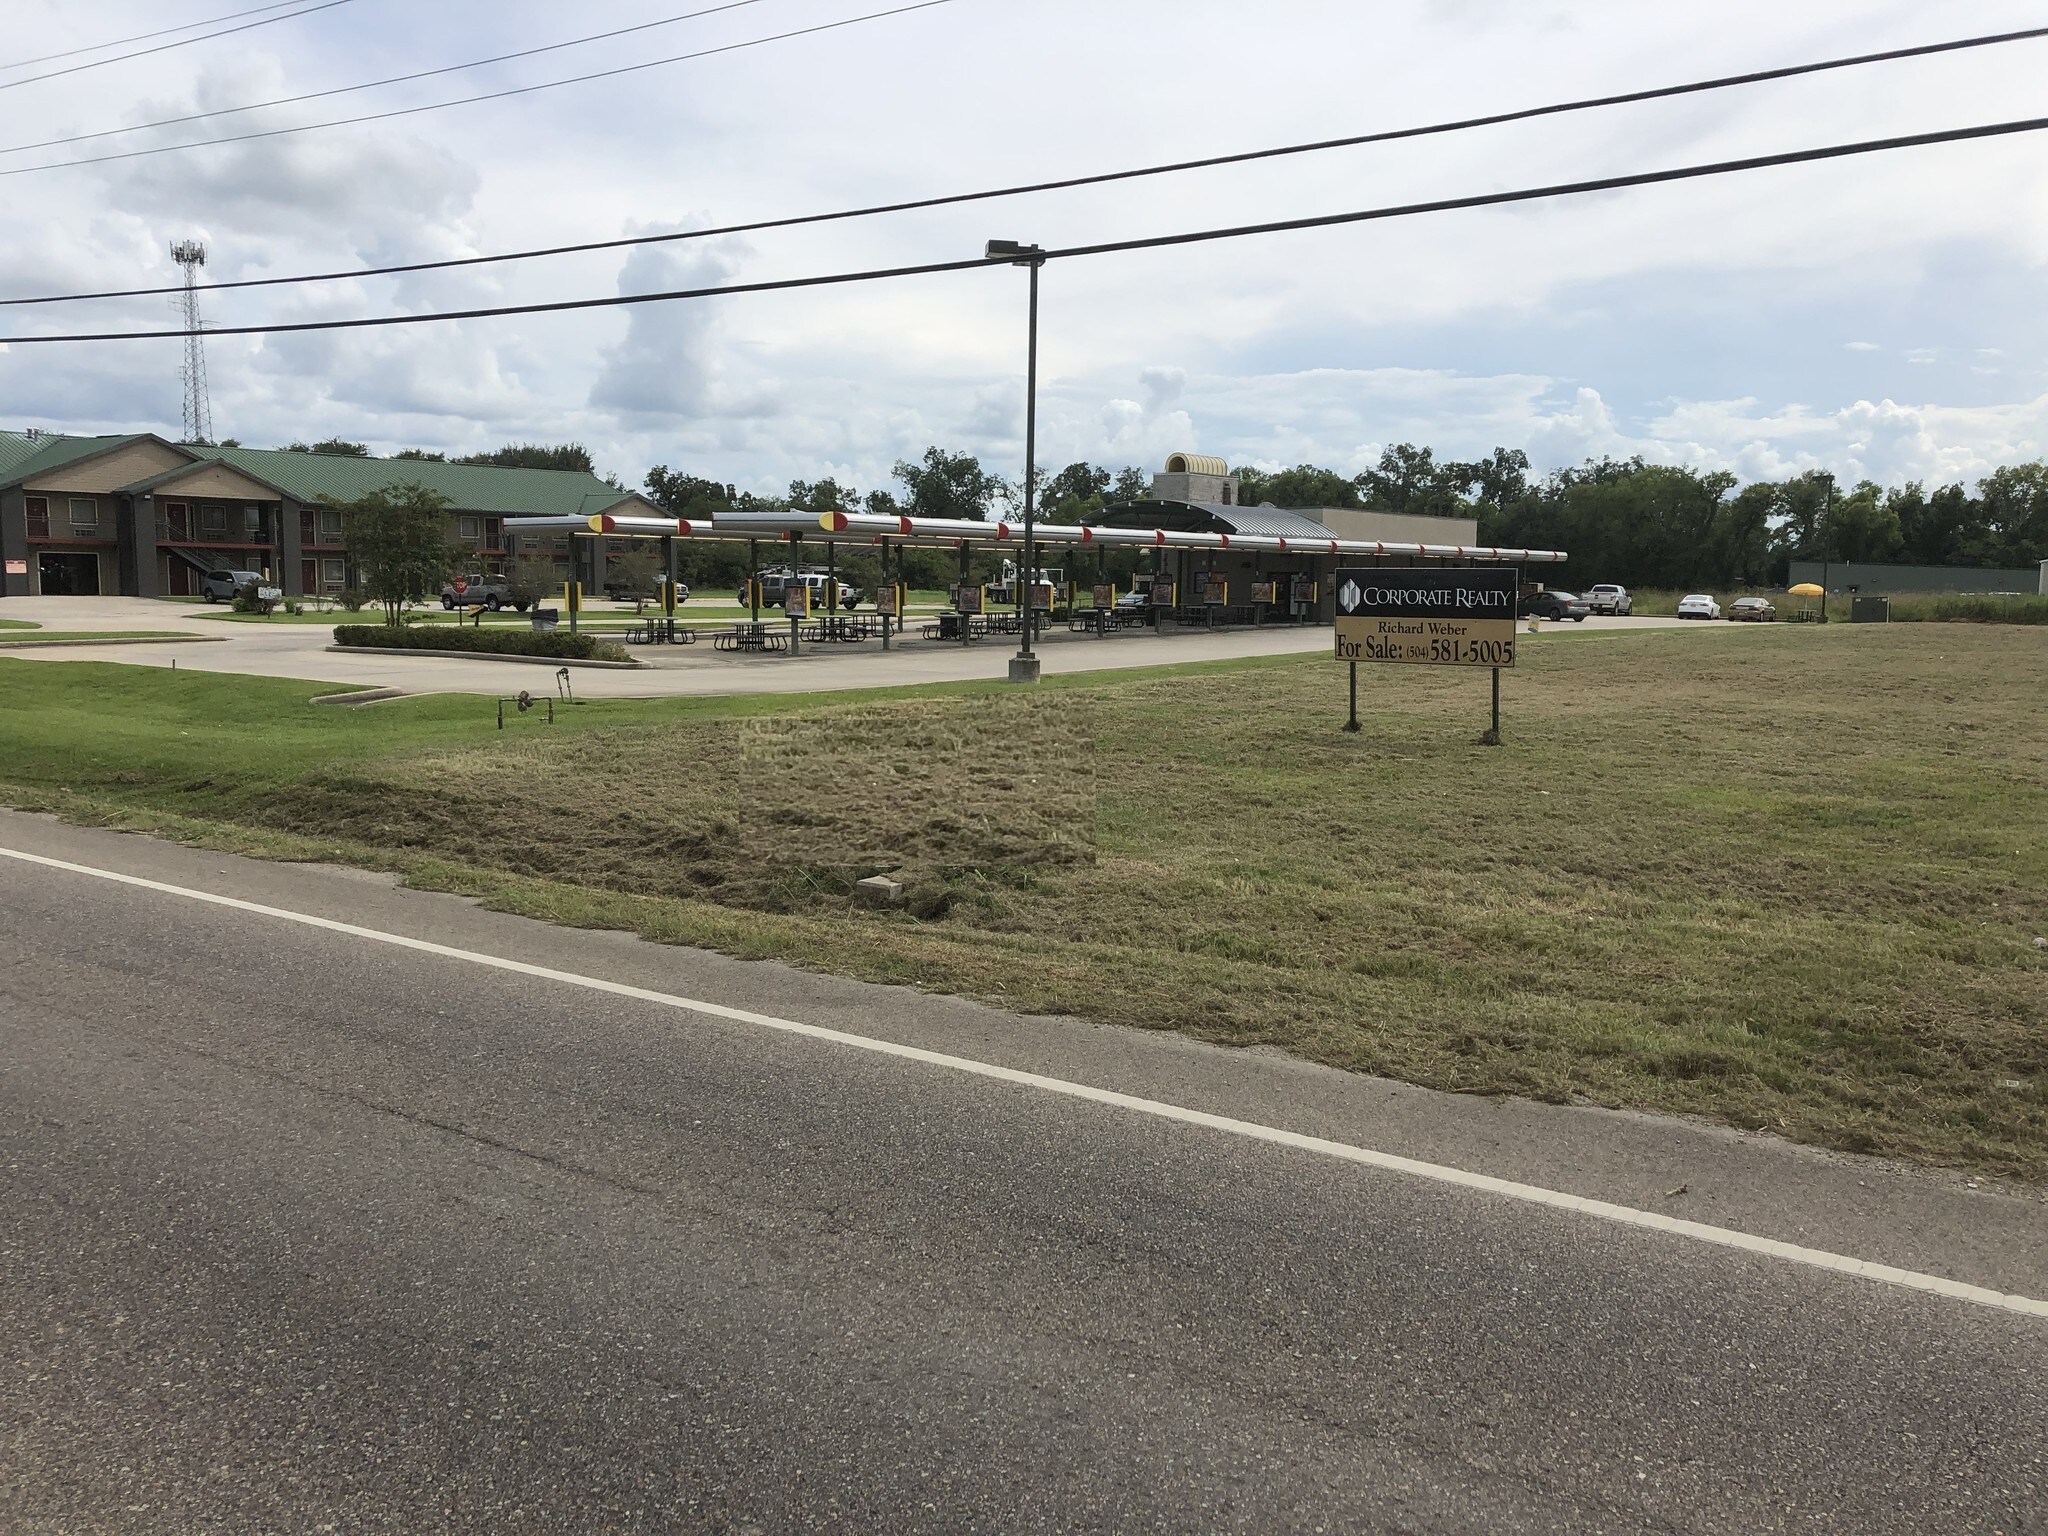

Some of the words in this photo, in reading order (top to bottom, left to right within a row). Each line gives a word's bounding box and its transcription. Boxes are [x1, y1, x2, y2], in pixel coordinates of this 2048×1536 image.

[454, 581, 467, 589] STOP
[1363, 586, 1452, 606] CORPORATE
[1455, 587, 1512, 608] REALTY
[1378, 621, 1423, 634] Richard
[1427, 622, 1467, 635] Weber
[1337, 634, 1361, 657] For
[1366, 635, 1403, 659] Sale:
[1406, 645, 1429, 660] (504)
[1430, 638, 1513, 663] 581-5005
